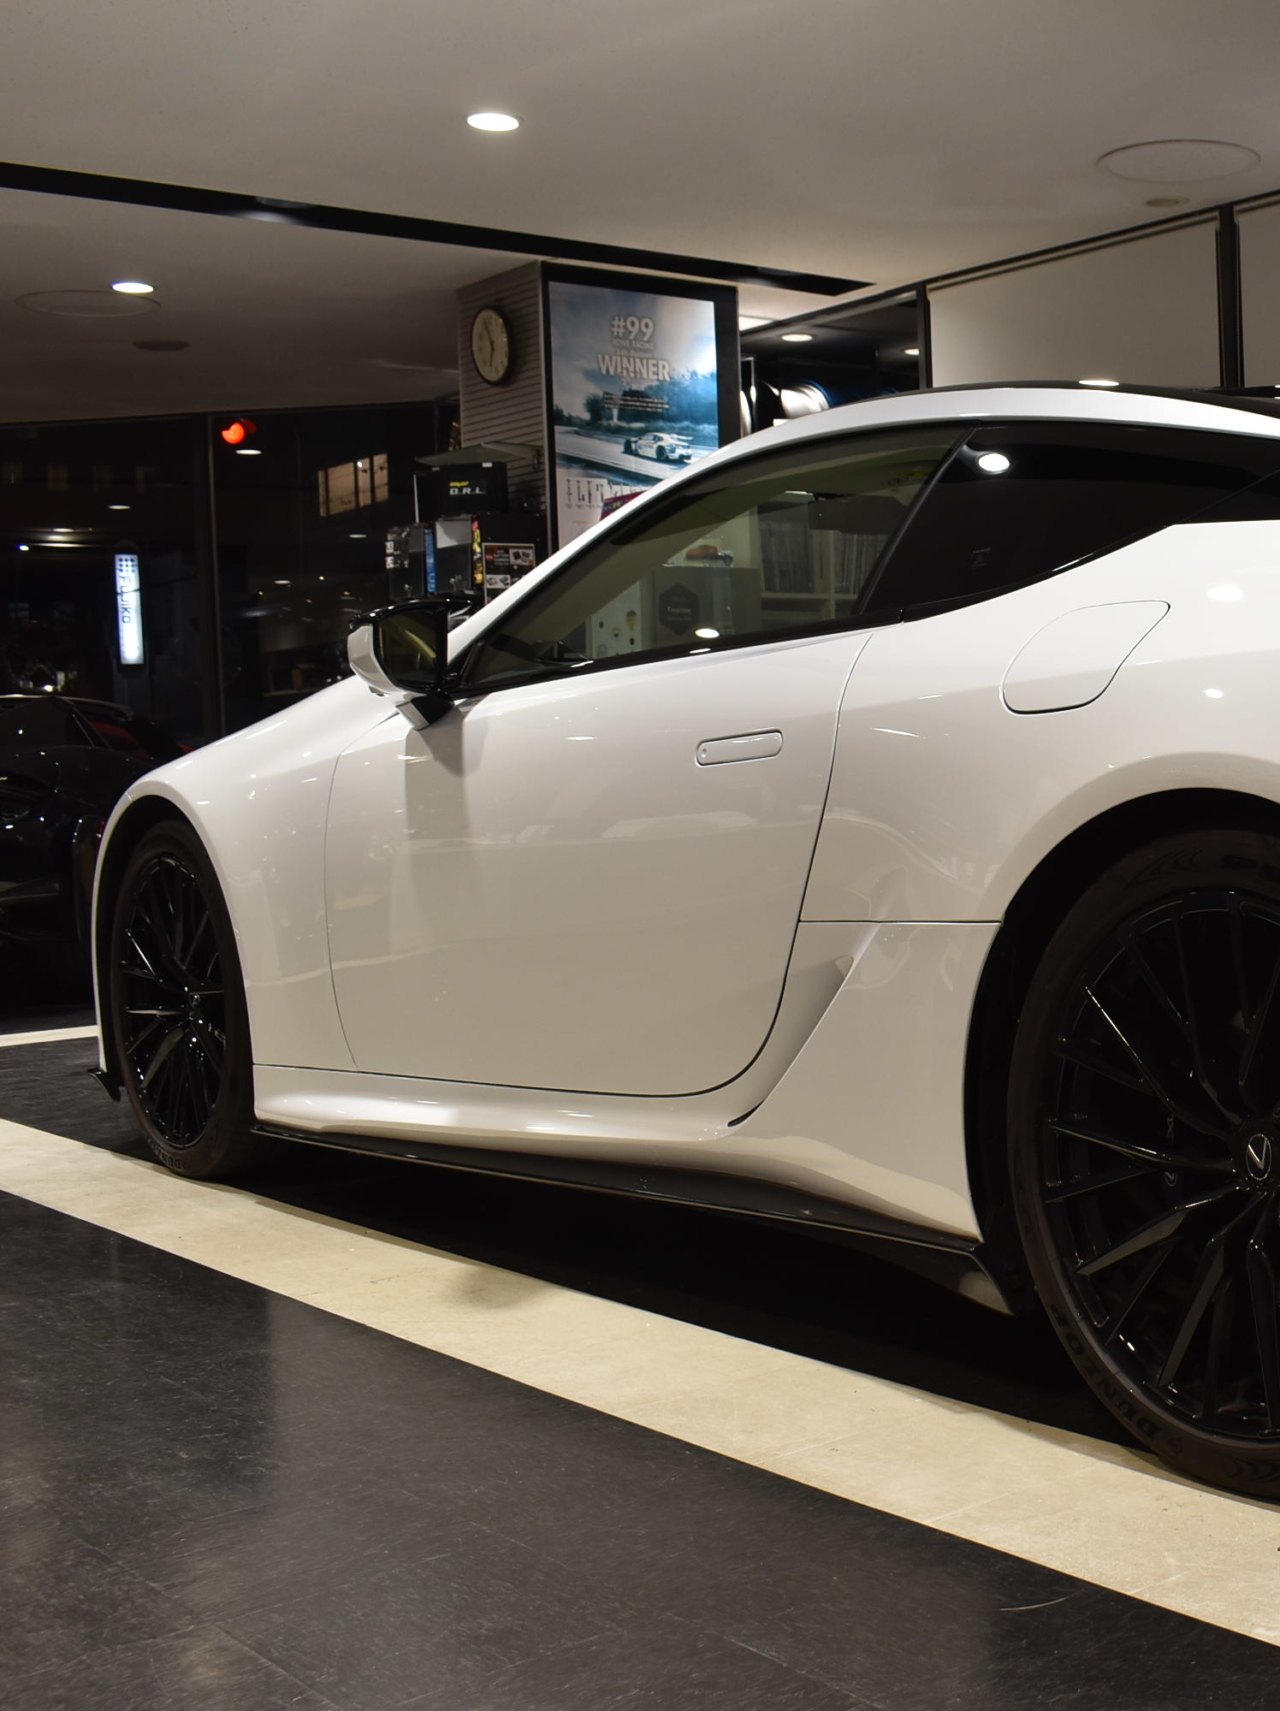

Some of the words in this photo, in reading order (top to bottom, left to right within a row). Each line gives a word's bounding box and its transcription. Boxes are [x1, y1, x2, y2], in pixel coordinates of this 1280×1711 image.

[611, 315, 654, 341] #99
[597, 354, 671, 381] WINNER
[119, 575, 132, 624] FUJIKO
